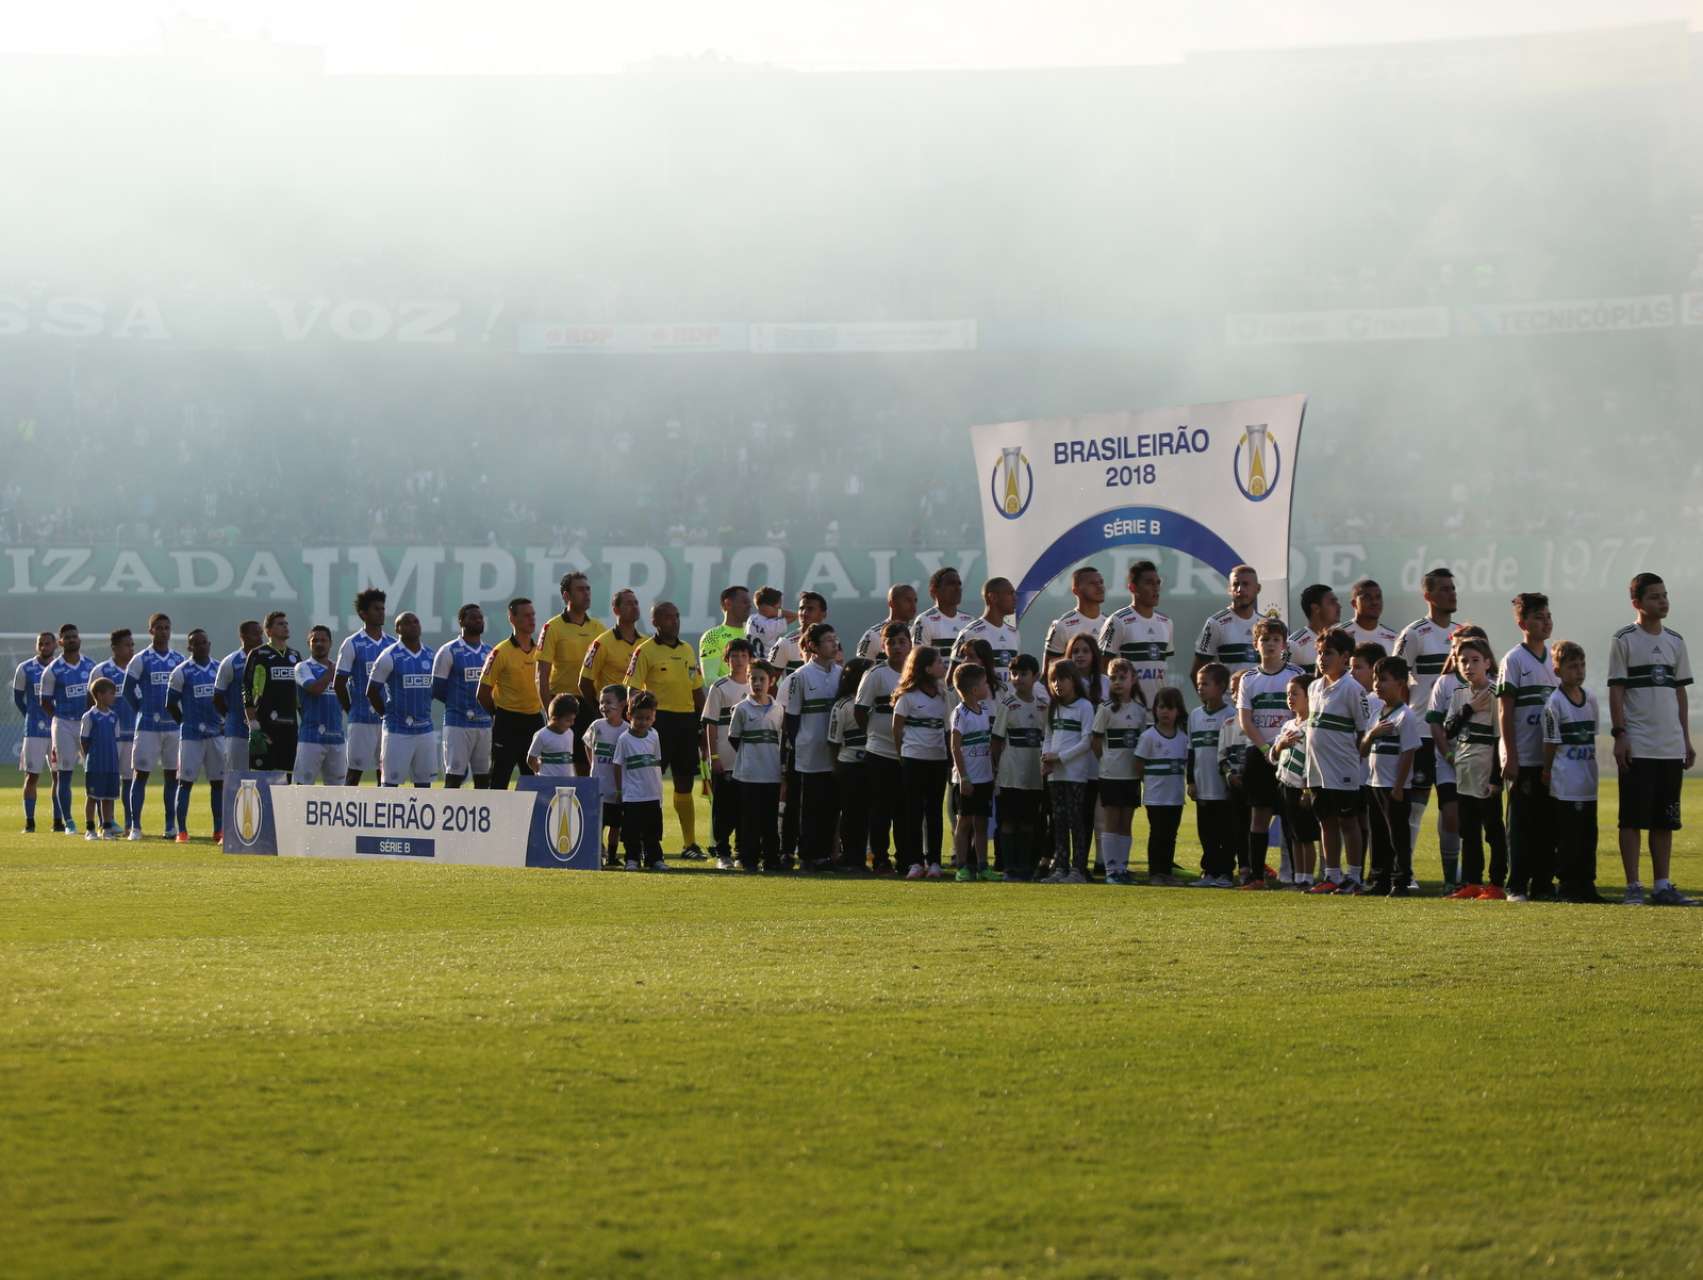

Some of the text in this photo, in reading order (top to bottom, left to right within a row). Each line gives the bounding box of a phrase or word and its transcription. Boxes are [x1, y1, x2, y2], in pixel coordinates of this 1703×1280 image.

[1053, 425, 1210, 464] BRASILEIRÃO
[1105, 464, 1156, 488] 2018
[1103, 518, 1161, 539] SÉRIE B
[5, 548, 298, 600] IZADA
[306, 797, 491, 833] BRASILEIRÃO 2018
[404, 842, 411, 854] B
